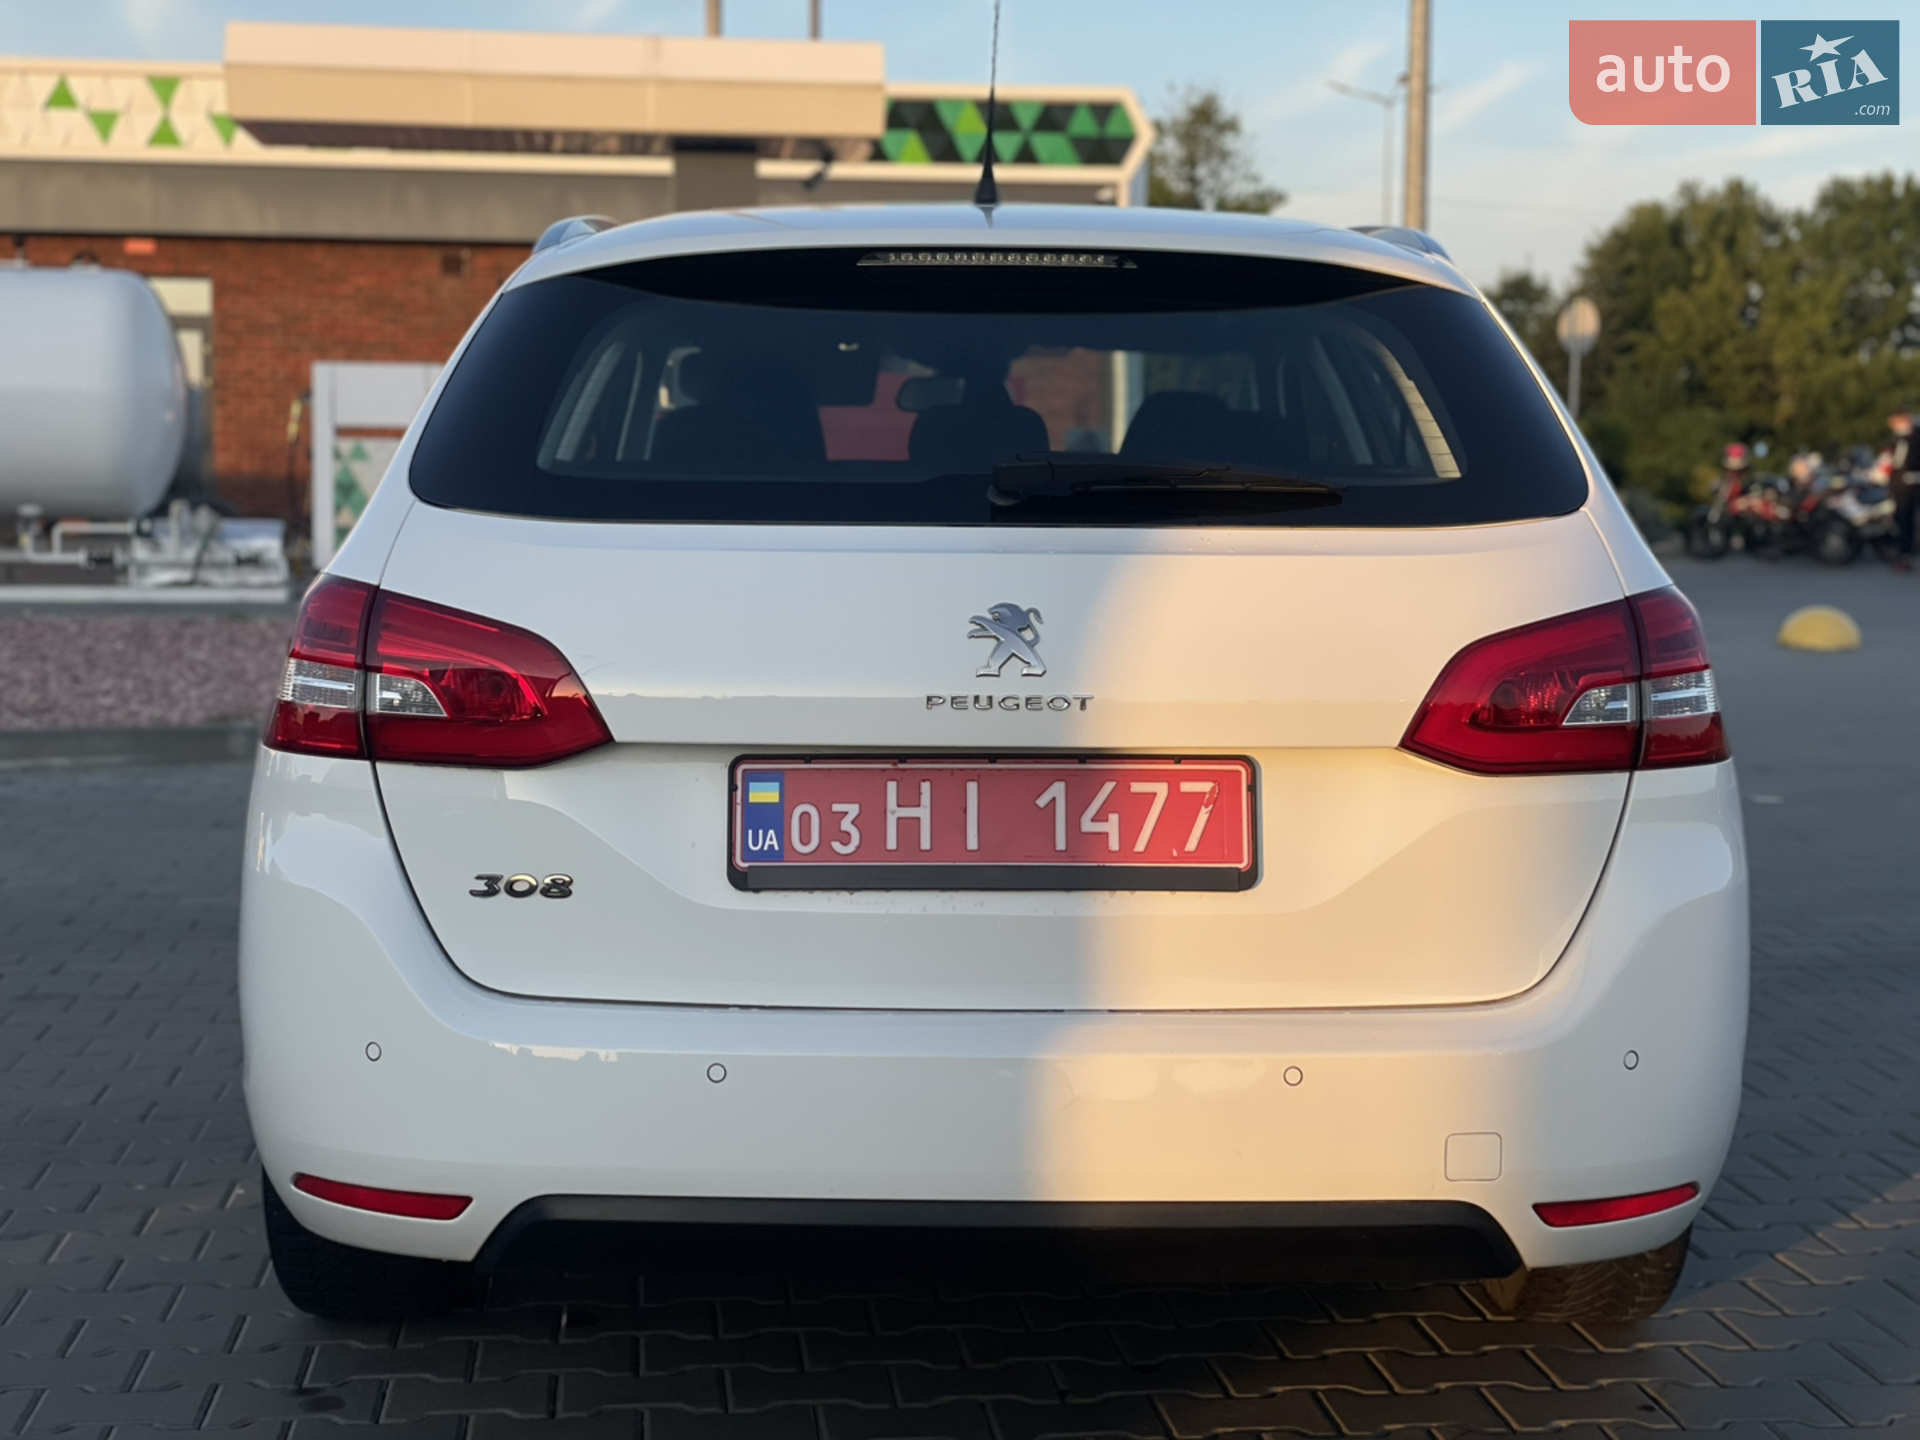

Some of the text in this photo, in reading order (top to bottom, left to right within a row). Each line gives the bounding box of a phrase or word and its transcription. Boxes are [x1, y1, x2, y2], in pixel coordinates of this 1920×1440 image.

[925, 694, 1094, 711] PEUGEOT
[747, 779, 1219, 855] UA 03 HI 1477
[468, 873, 573, 899] 308
